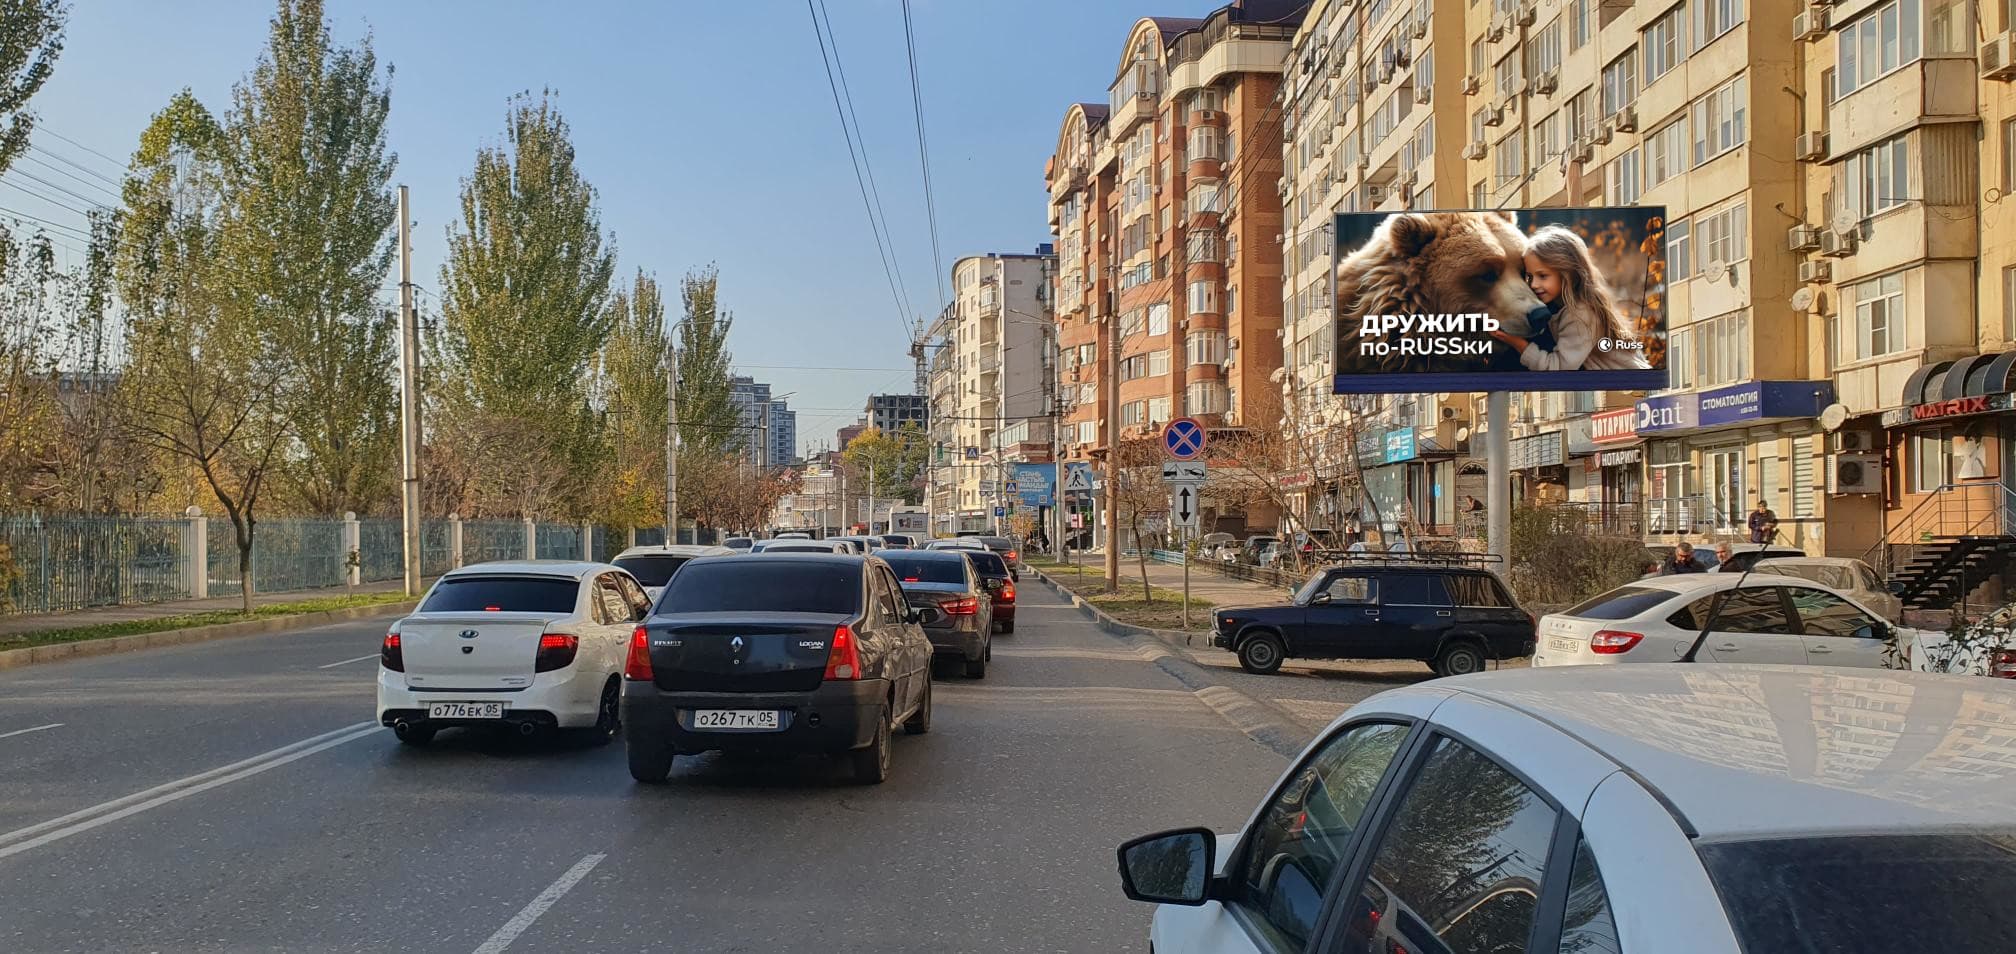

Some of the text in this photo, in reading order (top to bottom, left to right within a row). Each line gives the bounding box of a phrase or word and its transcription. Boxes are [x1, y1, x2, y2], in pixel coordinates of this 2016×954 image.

[1359, 313, 1500, 337] ДРУЖИТЬ
[1615, 339, 1644, 350] Russ
[1702, 391, 1758, 410] СТОМАТОЛОГИЯ
[1914, 397, 1986, 418] MATRIX
[1592, 411, 1636, 439] НОТАРИУС
[1601, 449, 1641, 467] НОТАРИУС
